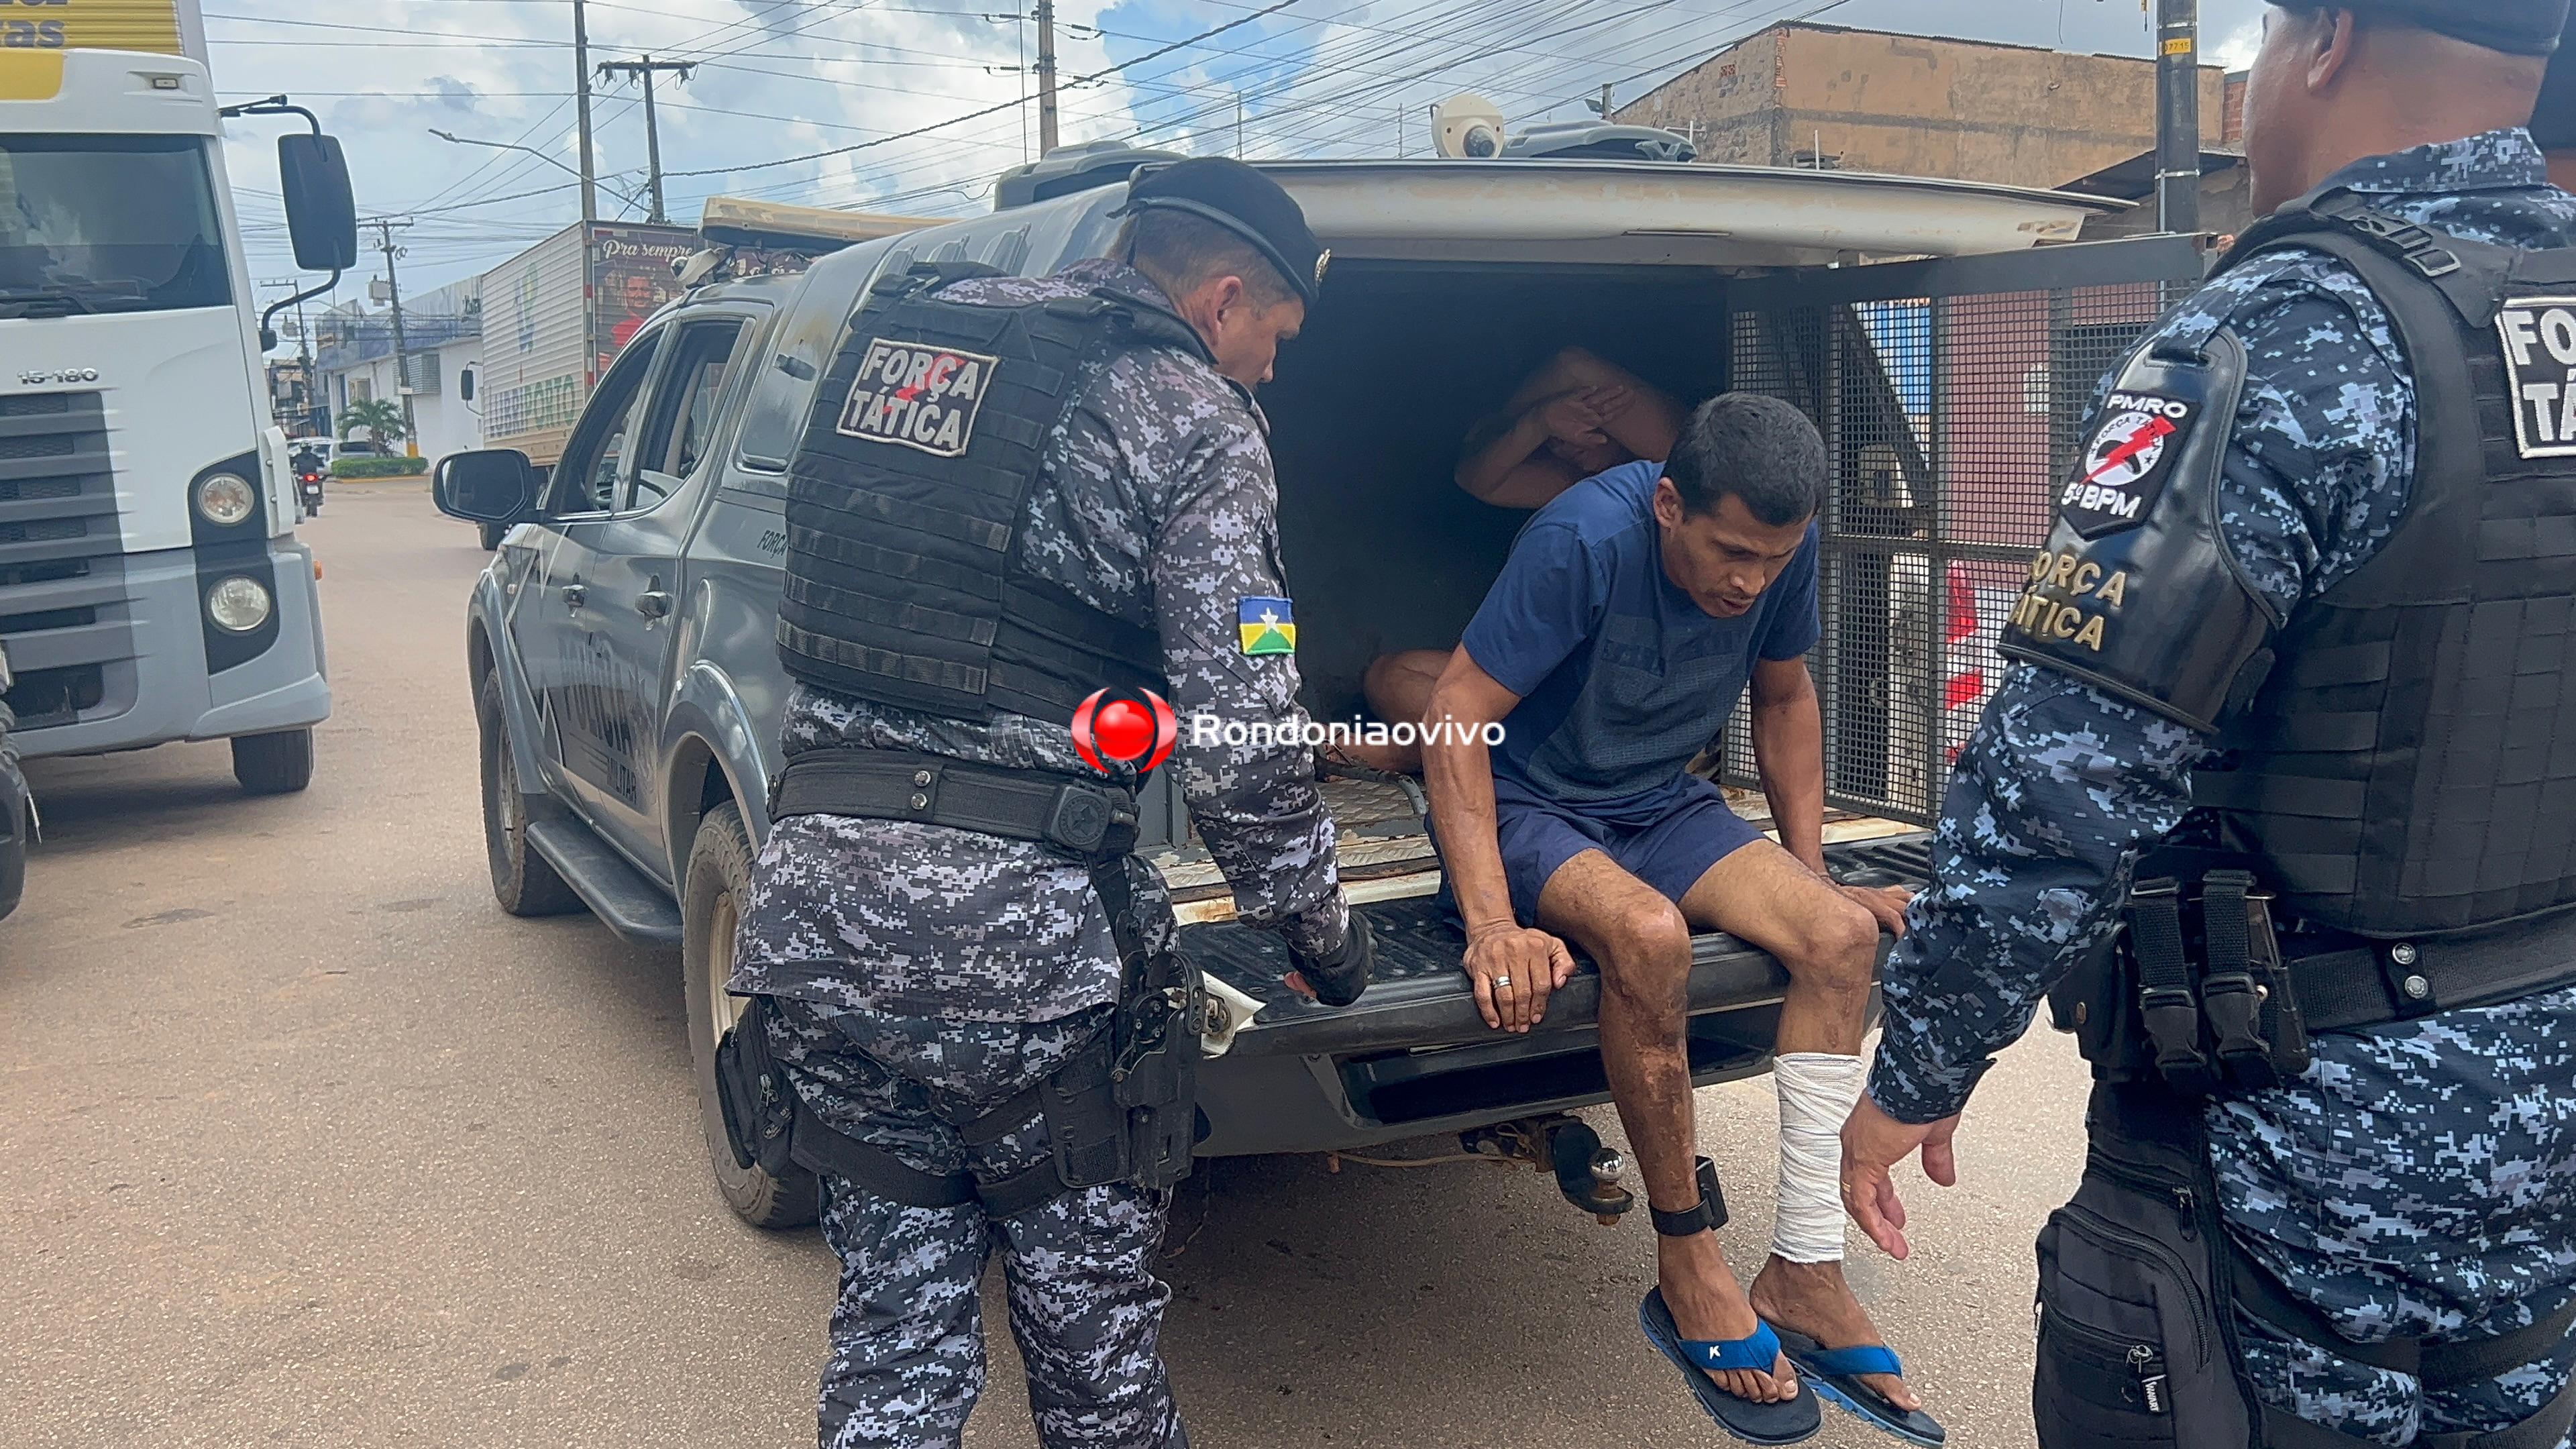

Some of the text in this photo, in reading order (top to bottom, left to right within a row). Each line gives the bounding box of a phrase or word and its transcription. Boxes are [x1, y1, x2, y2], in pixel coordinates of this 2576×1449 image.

[0, 20, 65, 48] as
[603, 239, 694, 262] Pra sempre
[17, 368, 99, 384] 15-180
[862, 347, 979, 402] FORÇA
[849, 386, 961, 449] TÁTICA
[2106, 394, 2188, 419] PMRO
[757, 530, 787, 559] FORÇA
[2031, 551, 2125, 606] ORÇA
[2008, 585, 2104, 651] ÁTICA
